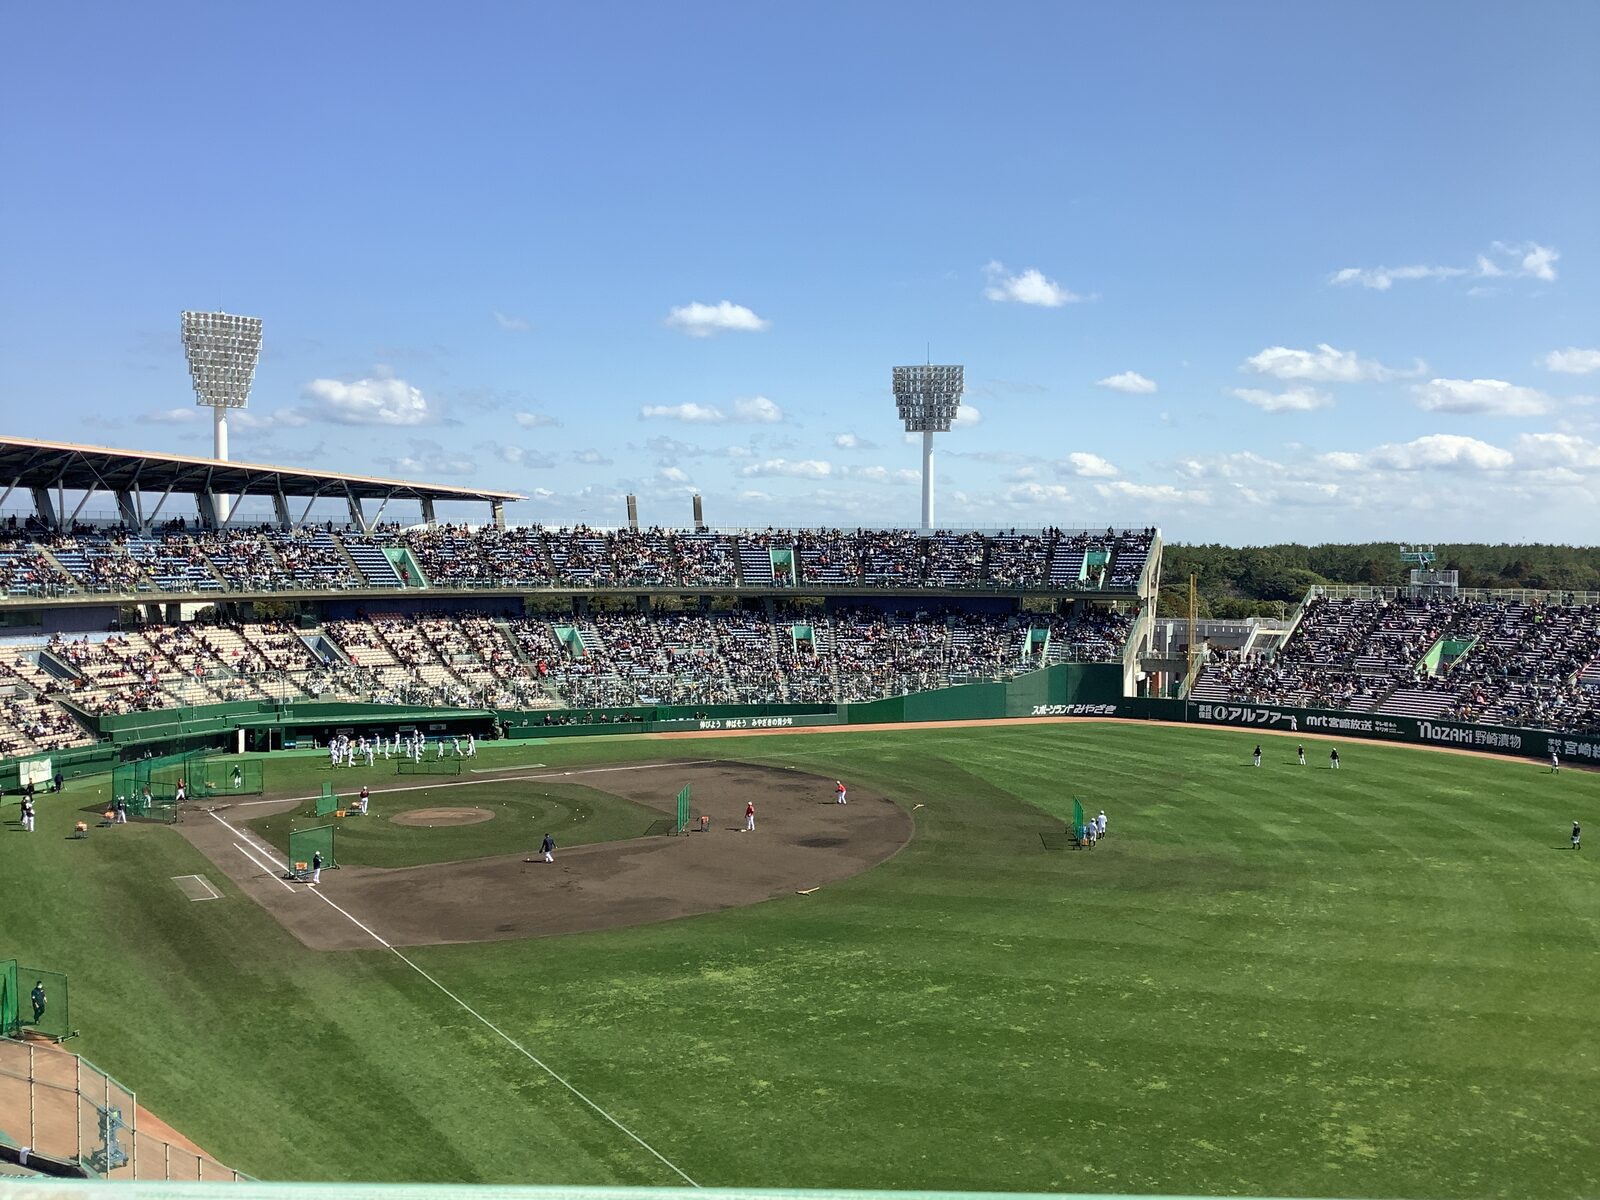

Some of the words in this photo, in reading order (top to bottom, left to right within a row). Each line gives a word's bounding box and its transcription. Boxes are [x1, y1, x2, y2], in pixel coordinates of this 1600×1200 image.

[1306, 715, 1328, 727] mrt
[1328, 717, 1372, 731] 宮崎放送
[1475, 730, 1522, 749] 野崎漬物
